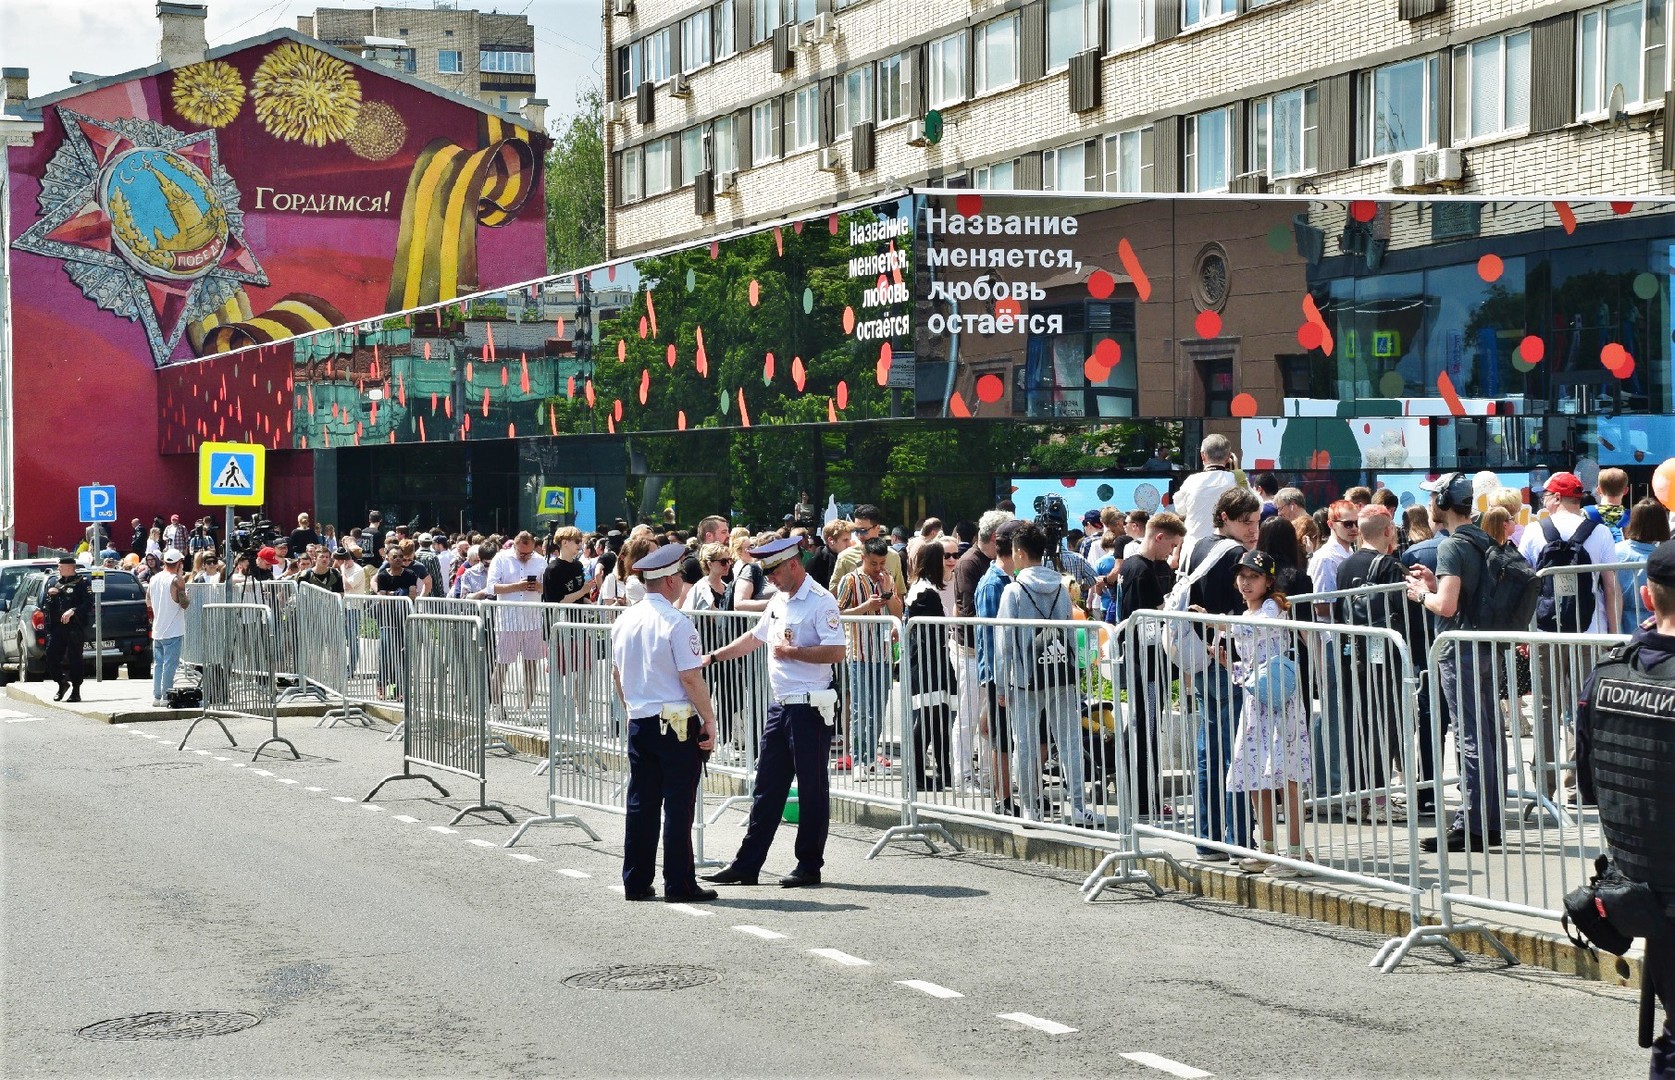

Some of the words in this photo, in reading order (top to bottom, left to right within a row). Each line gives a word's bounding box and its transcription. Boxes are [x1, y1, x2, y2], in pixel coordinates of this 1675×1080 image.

[849, 216, 909, 247] Название
[926, 207, 1078, 235] Название
[178, 238, 223, 267] ПОБЕДА
[849, 249, 910, 279] меняется,
[926, 247, 1083, 274] меняется,
[862, 281, 909, 308] любовь
[927, 275, 1047, 301] любовь
[856, 311, 910, 341] остаётся
[927, 308, 1063, 334] остаётся
[1600, 685, 1675, 713] ПОЛИЦИ
